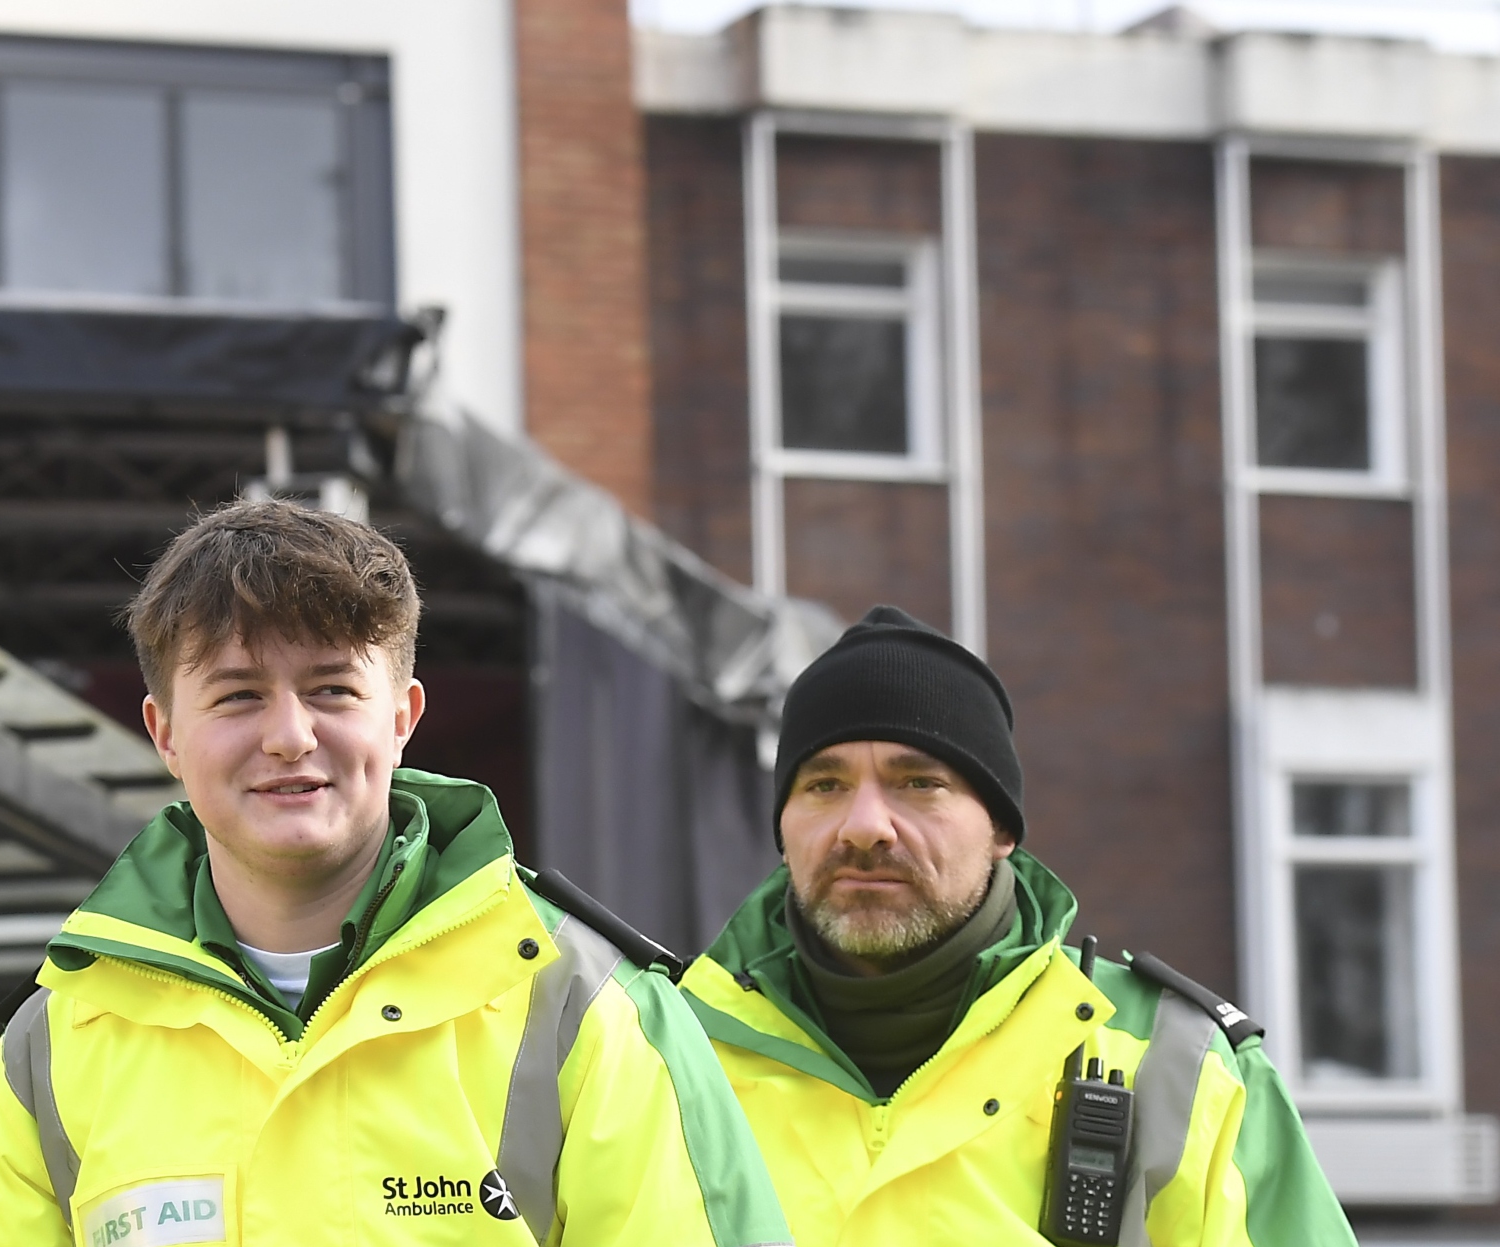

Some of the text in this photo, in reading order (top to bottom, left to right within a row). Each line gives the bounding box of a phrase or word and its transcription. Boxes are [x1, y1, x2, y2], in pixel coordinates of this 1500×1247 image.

[382, 1175, 472, 1200] St John
[157, 1199, 217, 1226] AID
[385, 1200, 474, 1217] Ambulance
